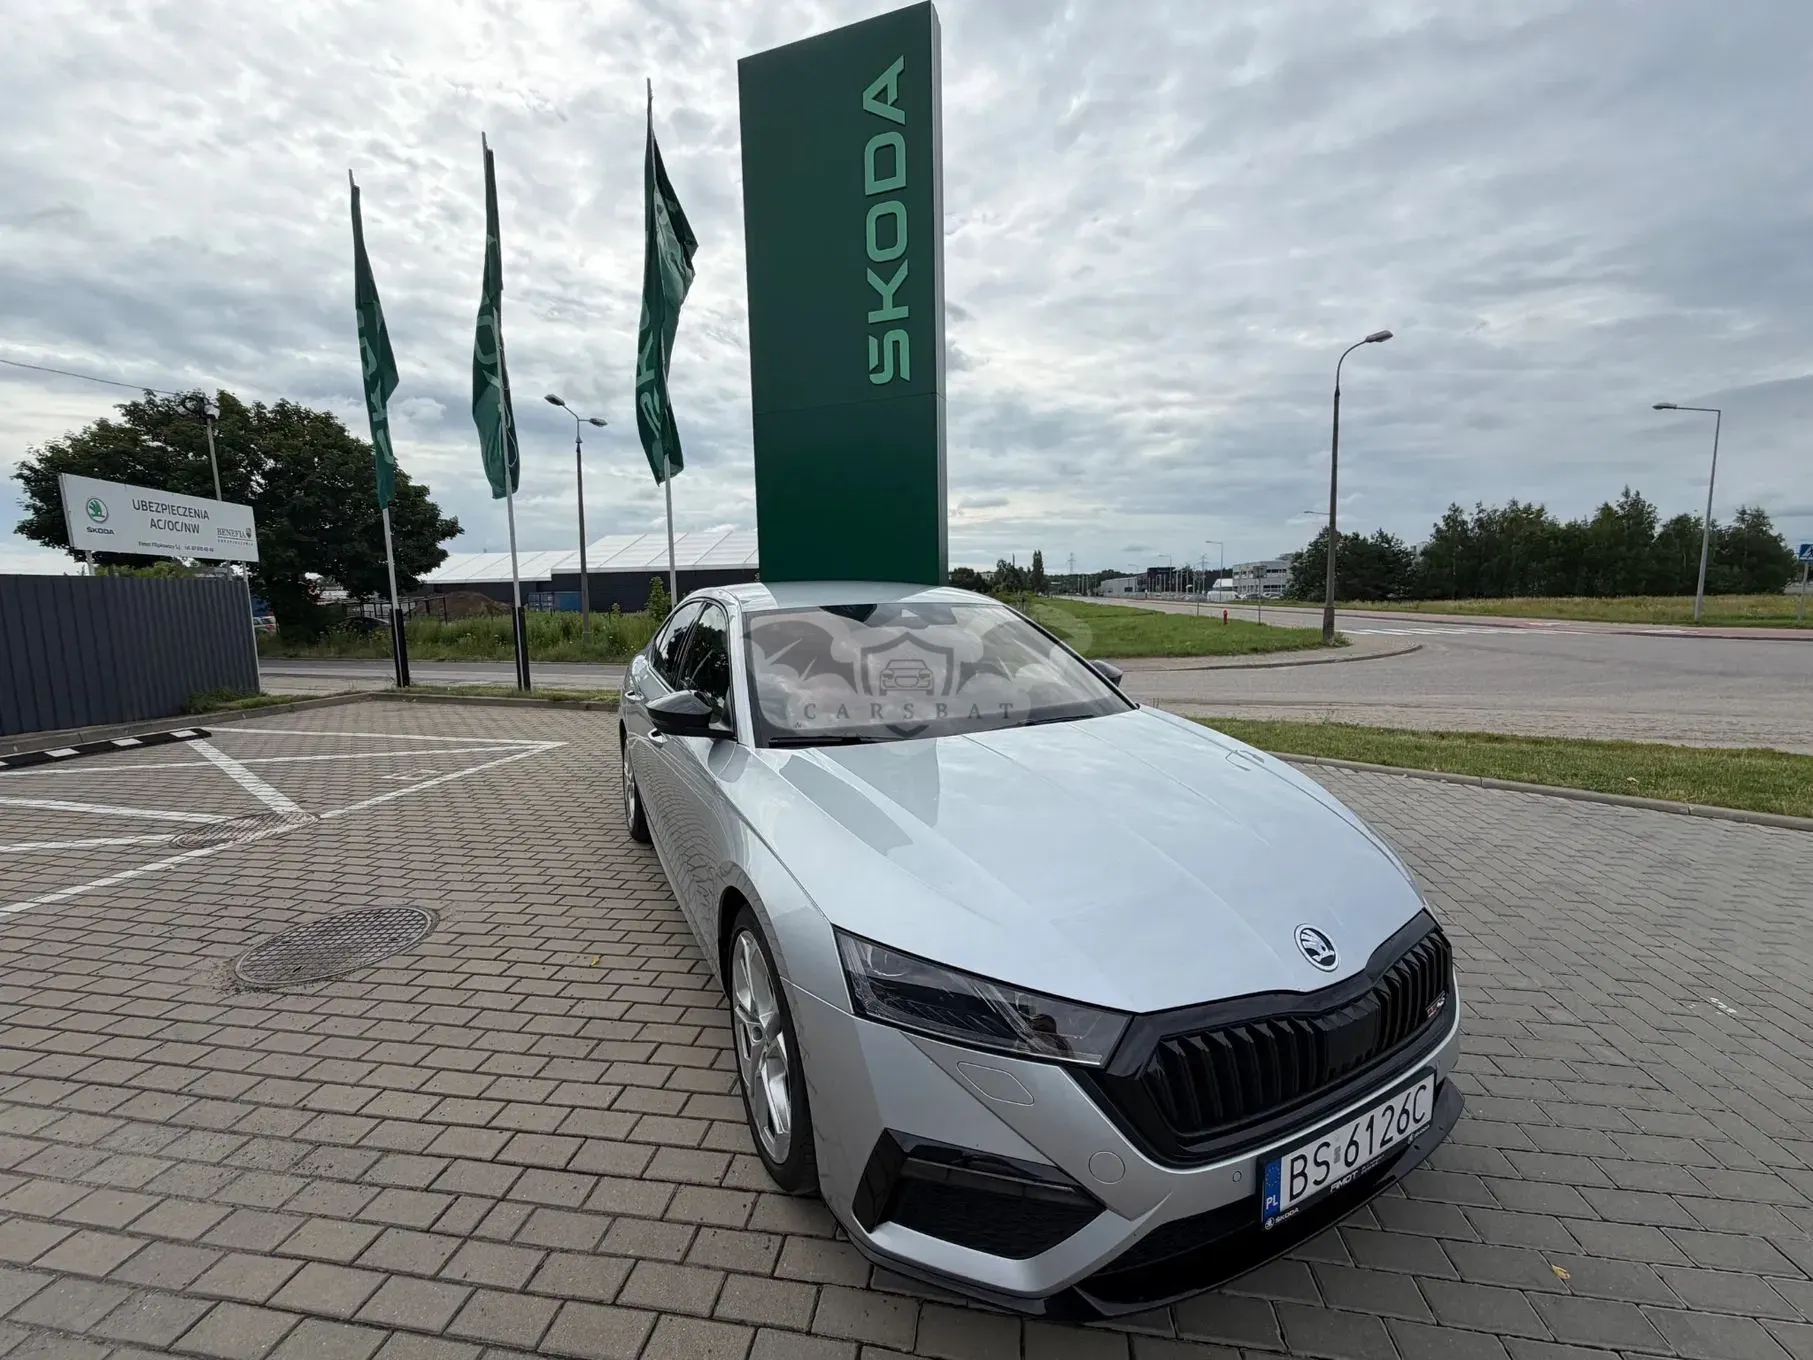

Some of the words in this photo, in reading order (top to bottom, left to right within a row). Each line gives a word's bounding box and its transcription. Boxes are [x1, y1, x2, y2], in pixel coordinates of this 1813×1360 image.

[132, 498, 210, 521] UBEZPIECZENIA
[150, 518, 200, 534] AC/OC/NW
[1289, 1141, 1331, 1202] BS
[1344, 1084, 1427, 1168] 6126C
[1266, 1195, 1279, 1210] PL
